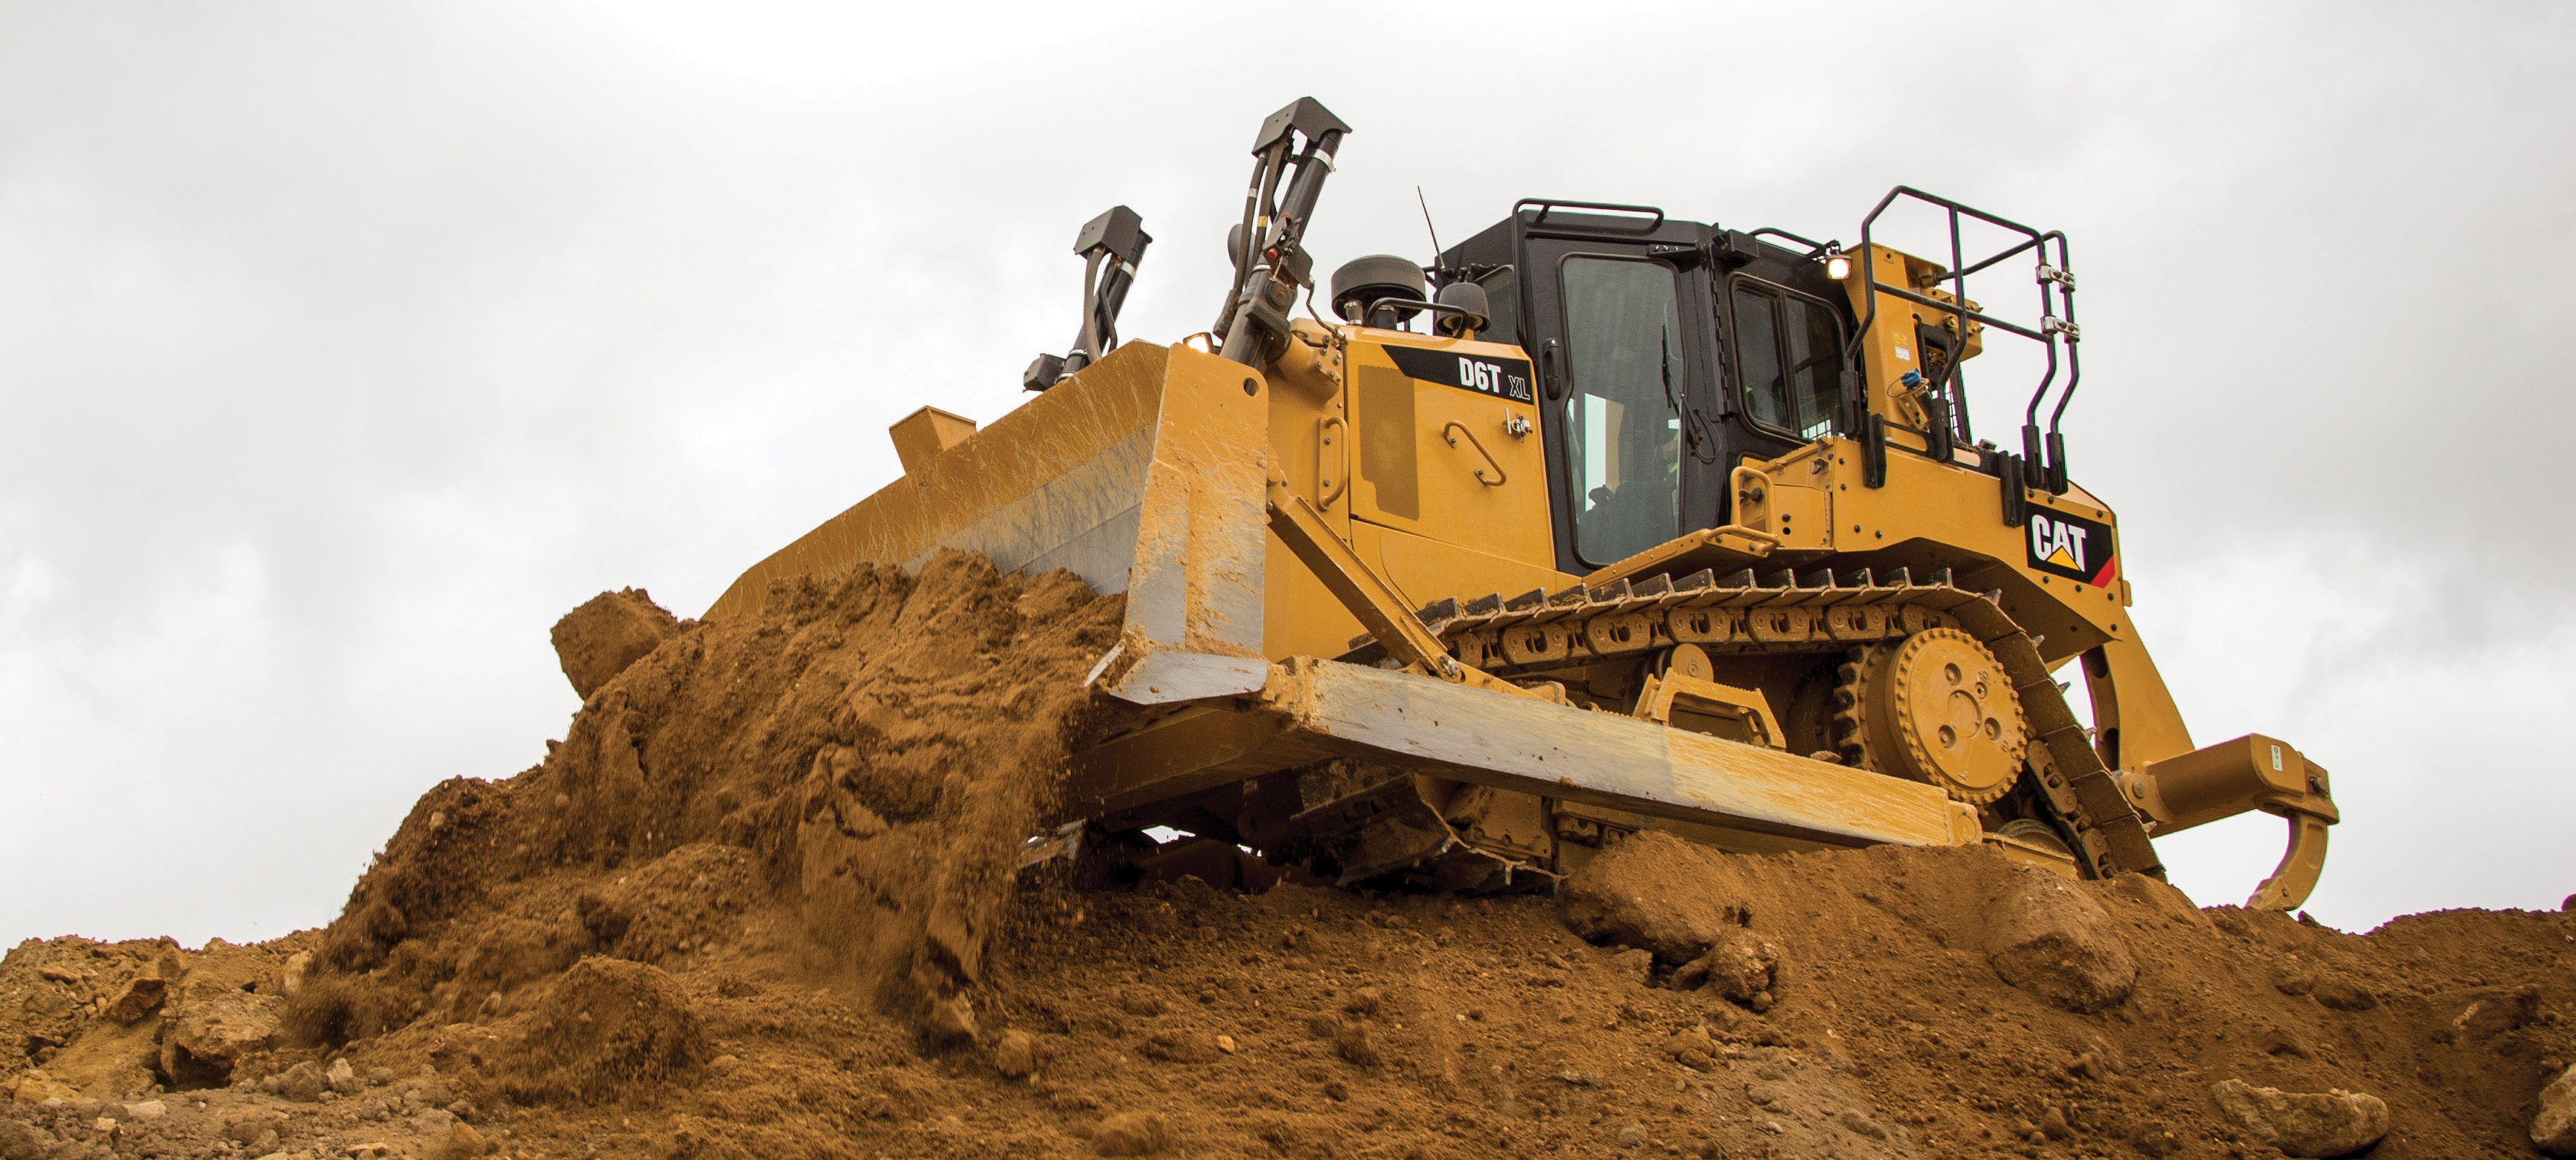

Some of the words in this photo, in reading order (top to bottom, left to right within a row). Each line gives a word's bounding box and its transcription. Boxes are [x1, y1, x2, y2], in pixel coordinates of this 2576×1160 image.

[1458, 357, 1502, 393] D6T
[1507, 375, 1531, 401] XL
[2031, 514, 2087, 572] CAT
